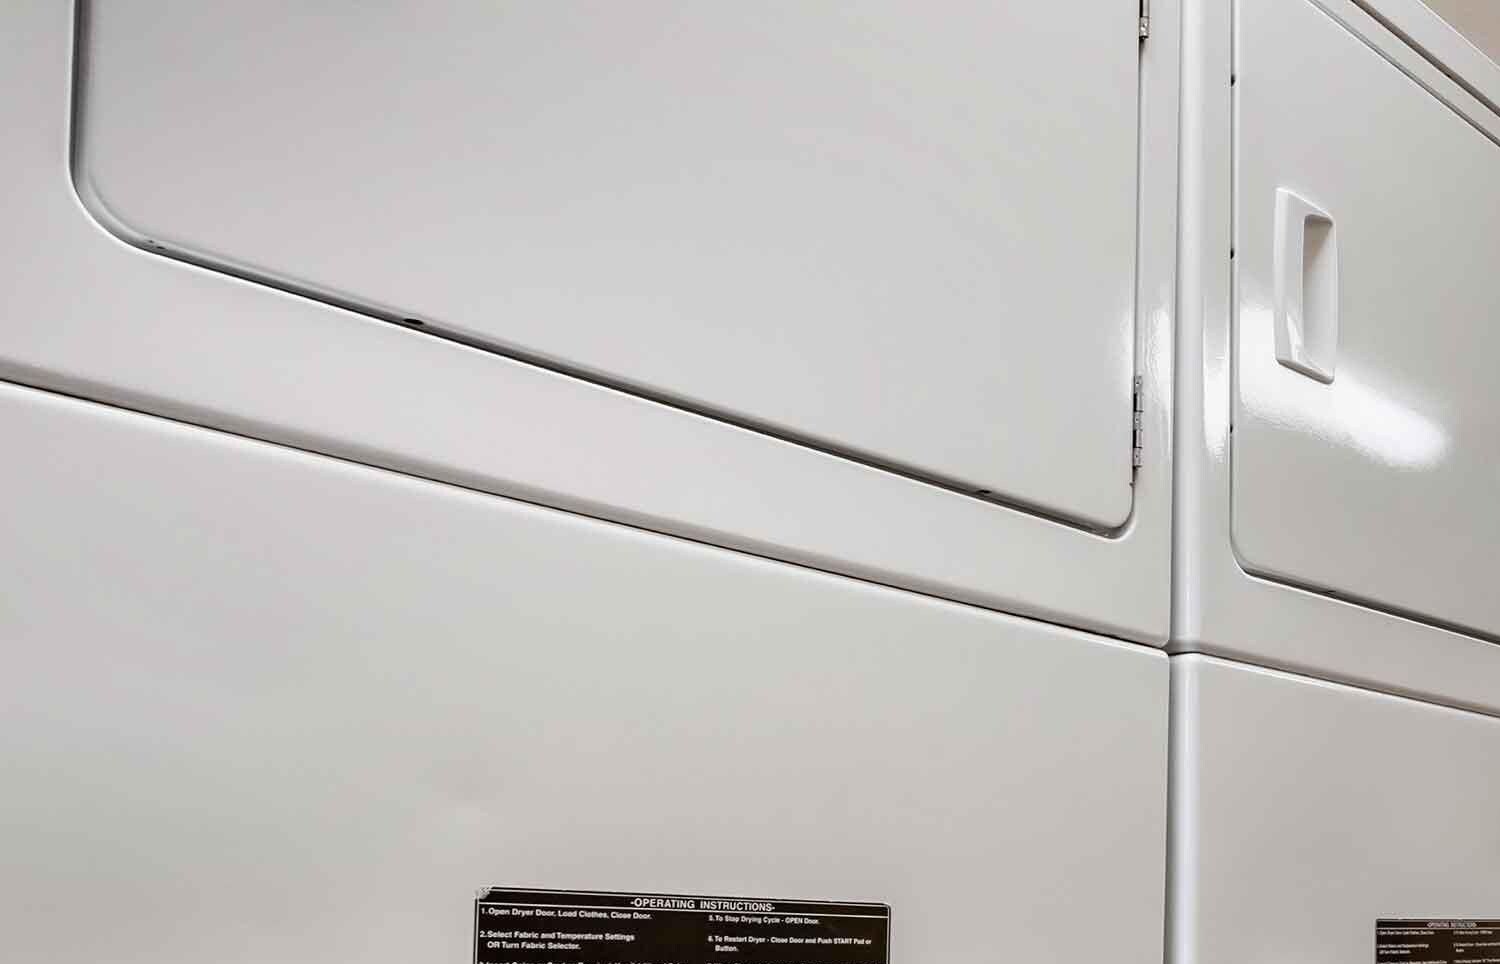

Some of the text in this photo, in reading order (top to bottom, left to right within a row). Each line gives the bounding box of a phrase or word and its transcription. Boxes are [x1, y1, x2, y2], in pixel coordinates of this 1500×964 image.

[512, 908, 534, 917] Dryer
[610, 911, 632, 919] Close
[514, 930, 539, 939] Fabric
[557, 932, 603, 941] Temperature
[604, 932, 636, 942] Settings
[487, 941, 501, 949] OR
[501, 941, 520, 949] Turn
